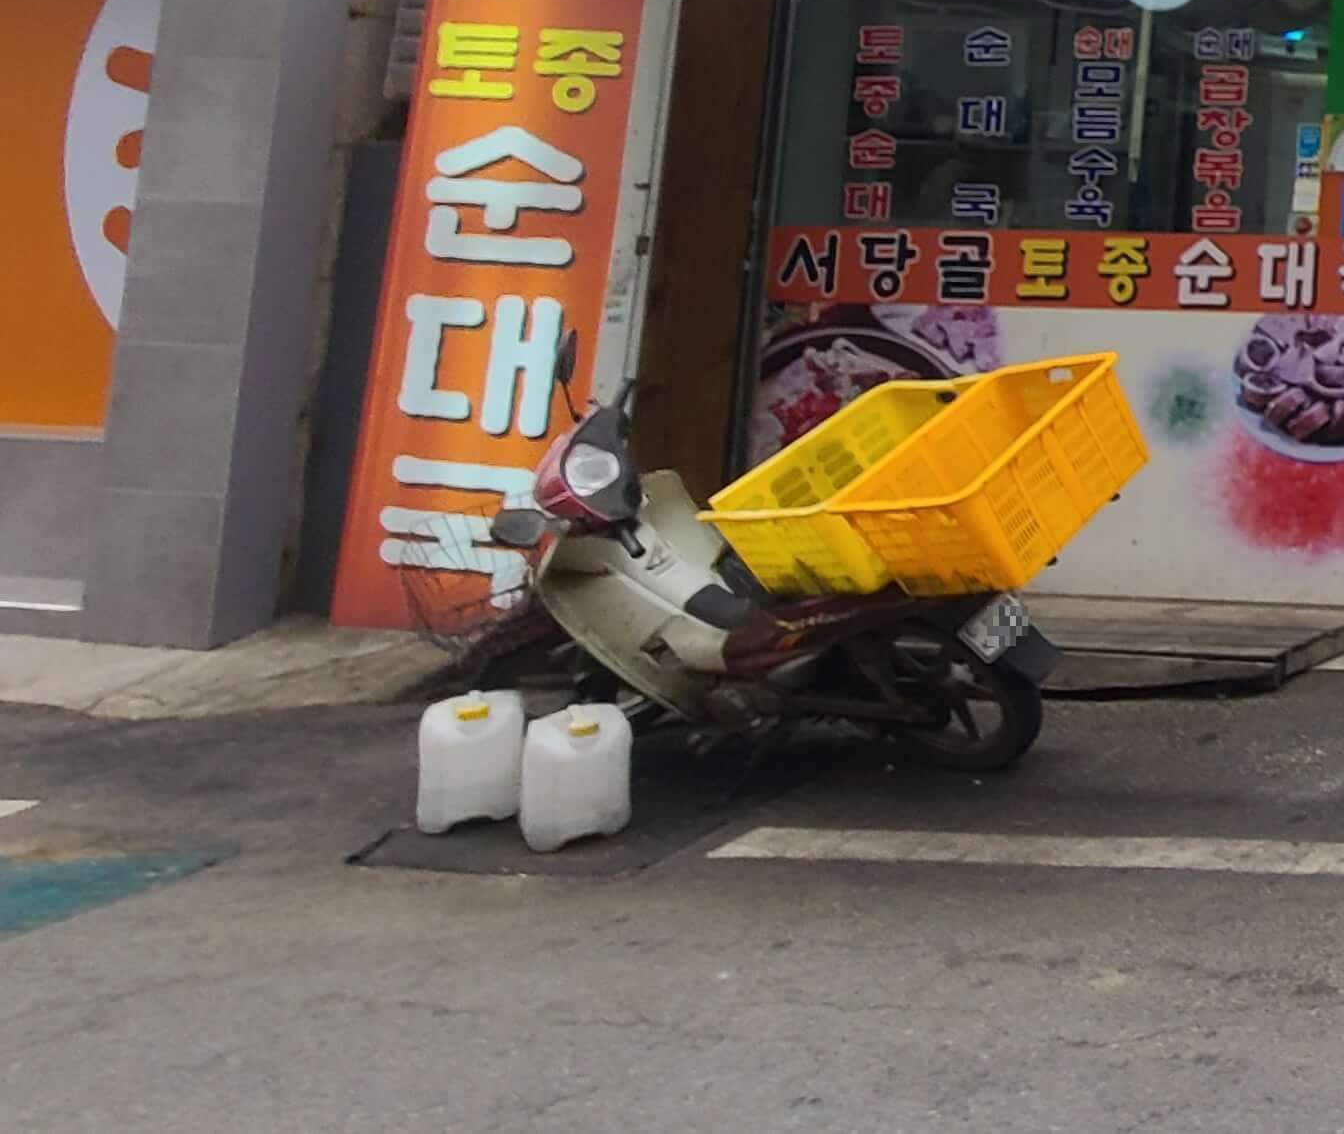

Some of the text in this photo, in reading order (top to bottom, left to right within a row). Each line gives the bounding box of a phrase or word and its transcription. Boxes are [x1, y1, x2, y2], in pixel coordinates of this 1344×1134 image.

[429, 21, 626, 114] 토종
[844, 26, 904, 222] 토종순대
[1073, 26, 1134, 60] 순대
[951, 26, 1011, 225] 순대국
[1065, 64, 1121, 226] 모듬수육
[1192, 65, 1252, 232] 곱창볶음
[780, 232, 994, 304] 서당골
[1015, 236, 1149, 304] 토종
[377, 125, 586, 611] 순대국
